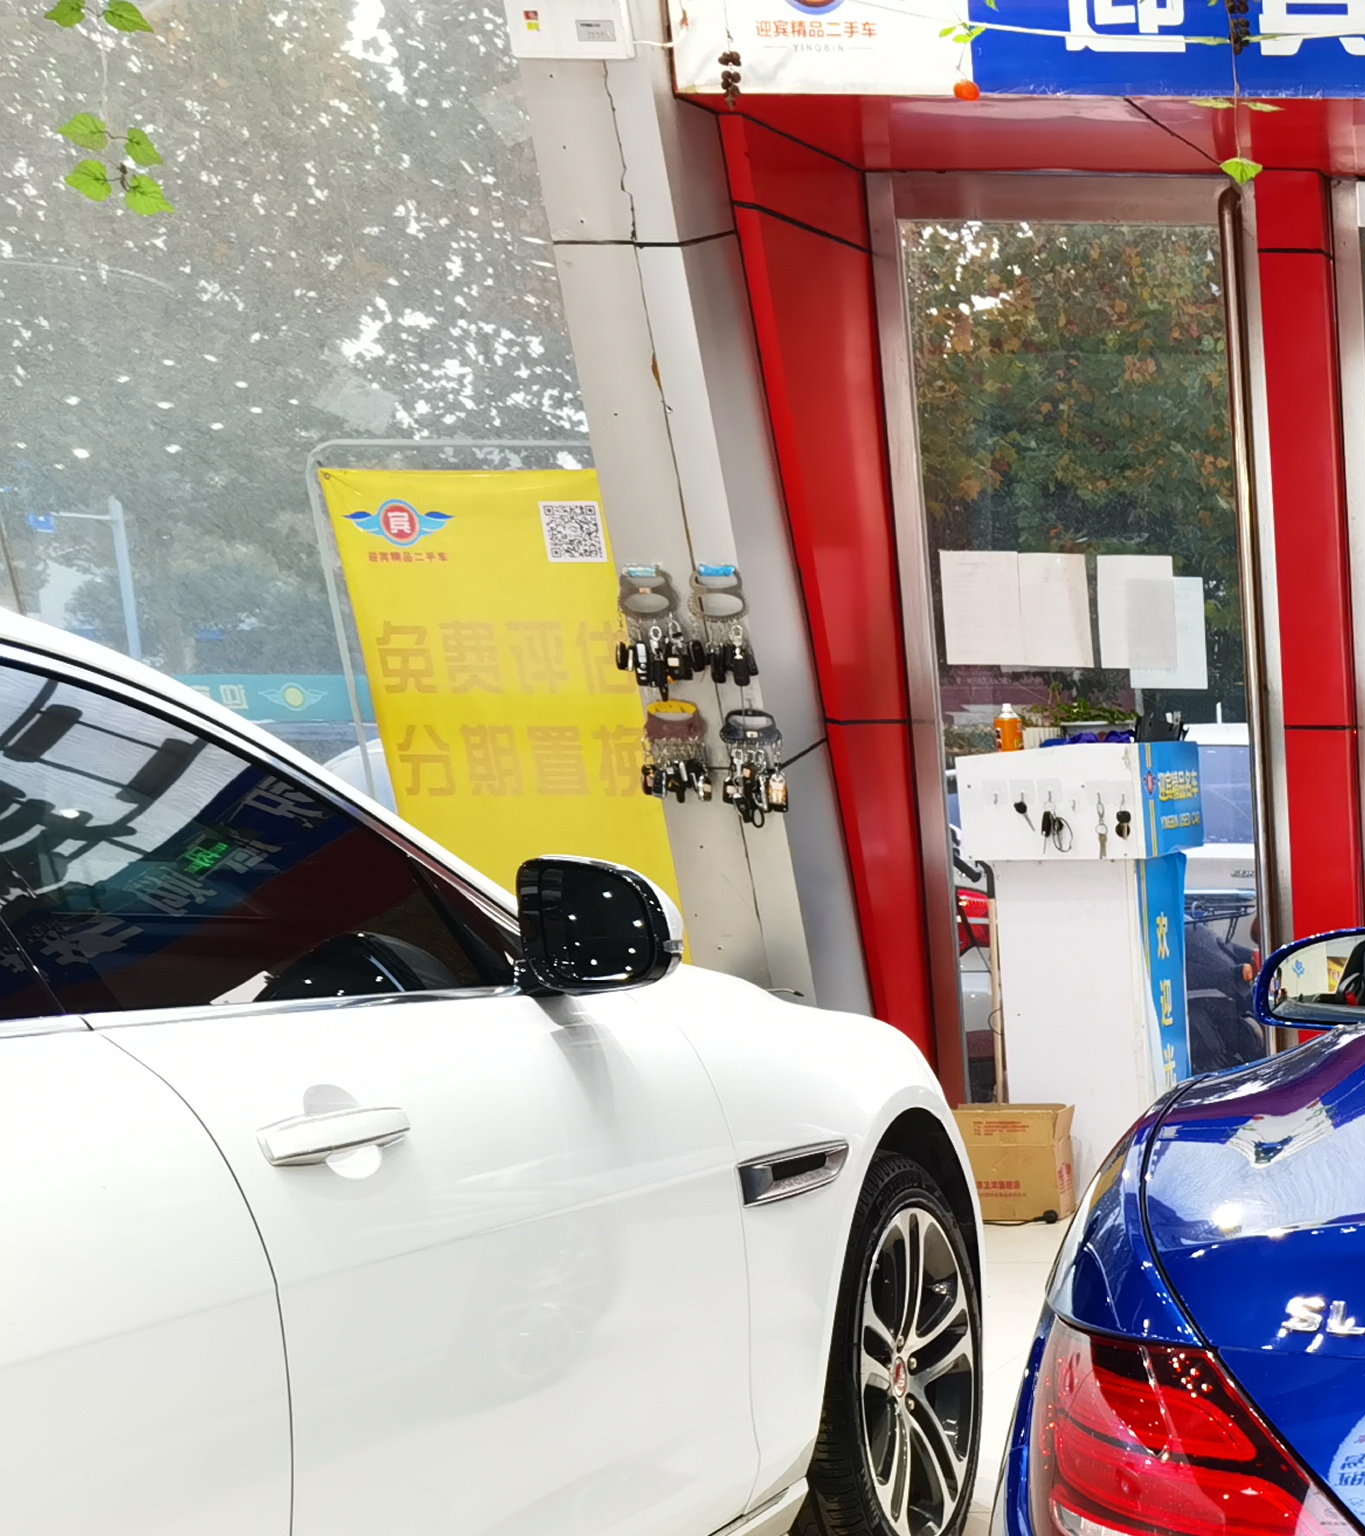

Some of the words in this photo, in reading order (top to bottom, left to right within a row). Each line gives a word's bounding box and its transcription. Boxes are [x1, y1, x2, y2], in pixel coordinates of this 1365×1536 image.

[755, 19, 878, 39] 迎宾精品二手车
[367, 550, 449, 563] 迎宾精品二手车
[376, 620, 638, 694] 免费评估
